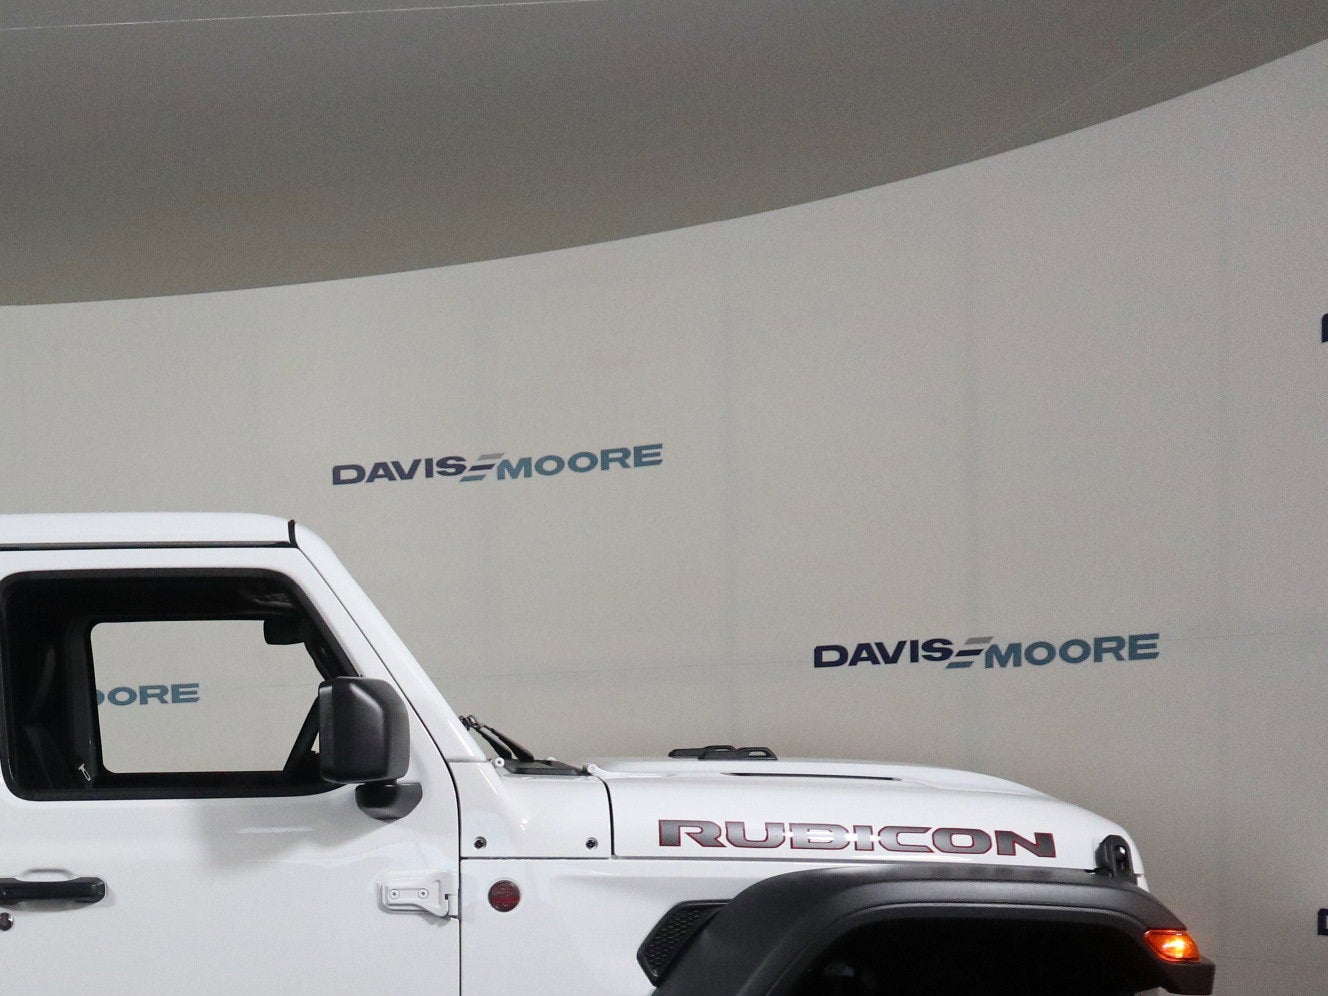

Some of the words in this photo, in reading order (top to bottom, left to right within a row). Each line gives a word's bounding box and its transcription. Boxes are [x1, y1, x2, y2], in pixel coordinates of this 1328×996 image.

[332, 455, 468, 485] DAVIS
[496, 443, 663, 481] MOORE
[813, 637, 954, 669] DAVIS
[985, 632, 1160, 669] MOORE
[96, 683, 201, 707] ORE
[658, 819, 1057, 858] RUBICON
